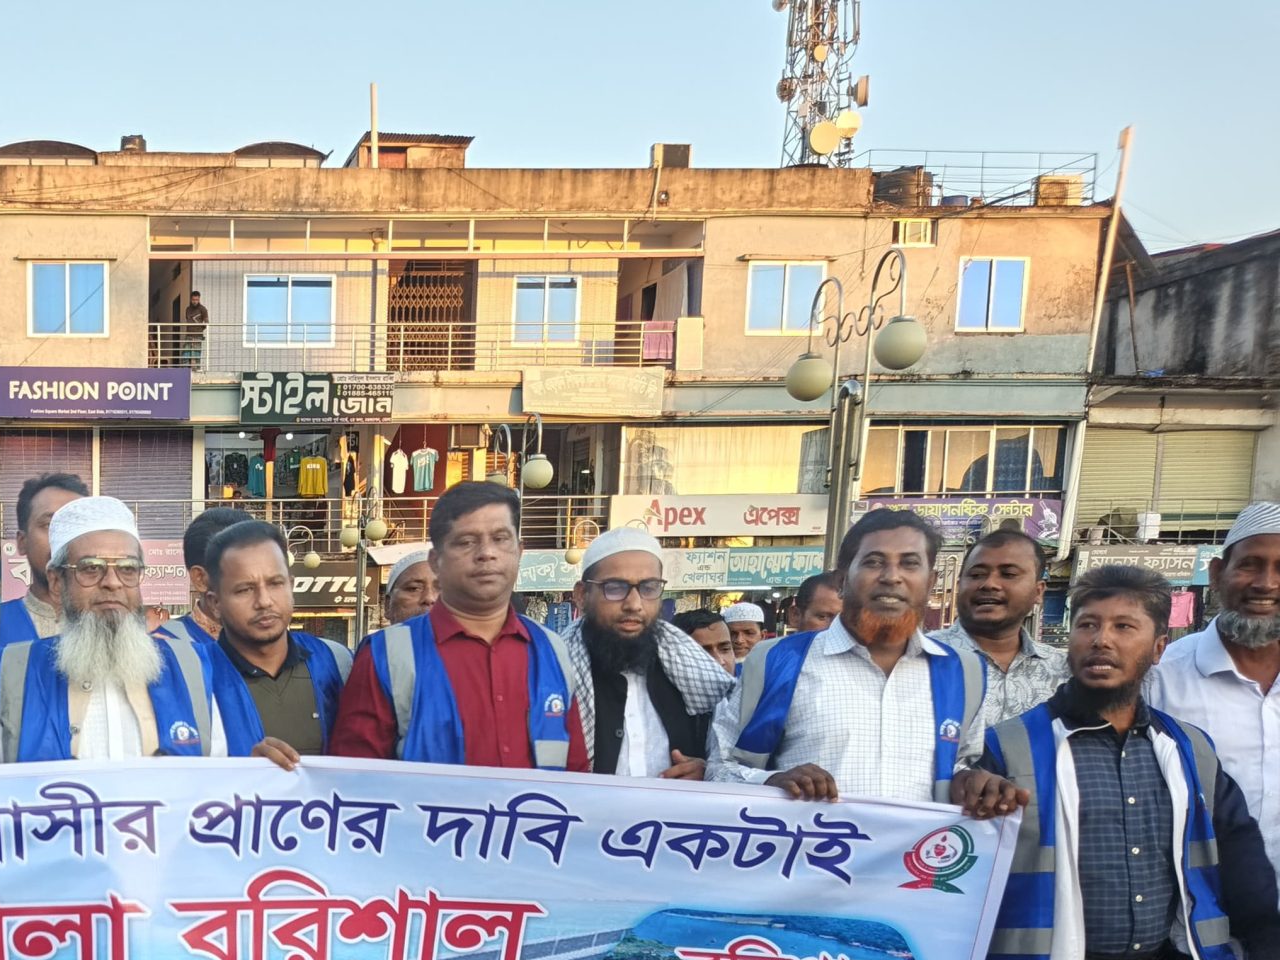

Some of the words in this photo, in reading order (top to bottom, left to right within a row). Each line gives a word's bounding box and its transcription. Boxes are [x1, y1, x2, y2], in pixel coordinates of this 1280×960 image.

[9, 381, 99, 400] FASHION
[107, 382, 172, 401] POINT
[241, 372, 330, 414] স্টাইল
[333, 397, 392, 416] জোন
[643, 499, 708, 532] Apex
[743, 505, 801, 526] এপেক্স
[686, 551, 727, 564] ফ্যাশন
[293, 576, 371, 593] OTTO
[190, 793, 399, 856] প্রাণের
[418, 793, 583, 865] দাবি
[601, 807, 871, 884] একটাই
